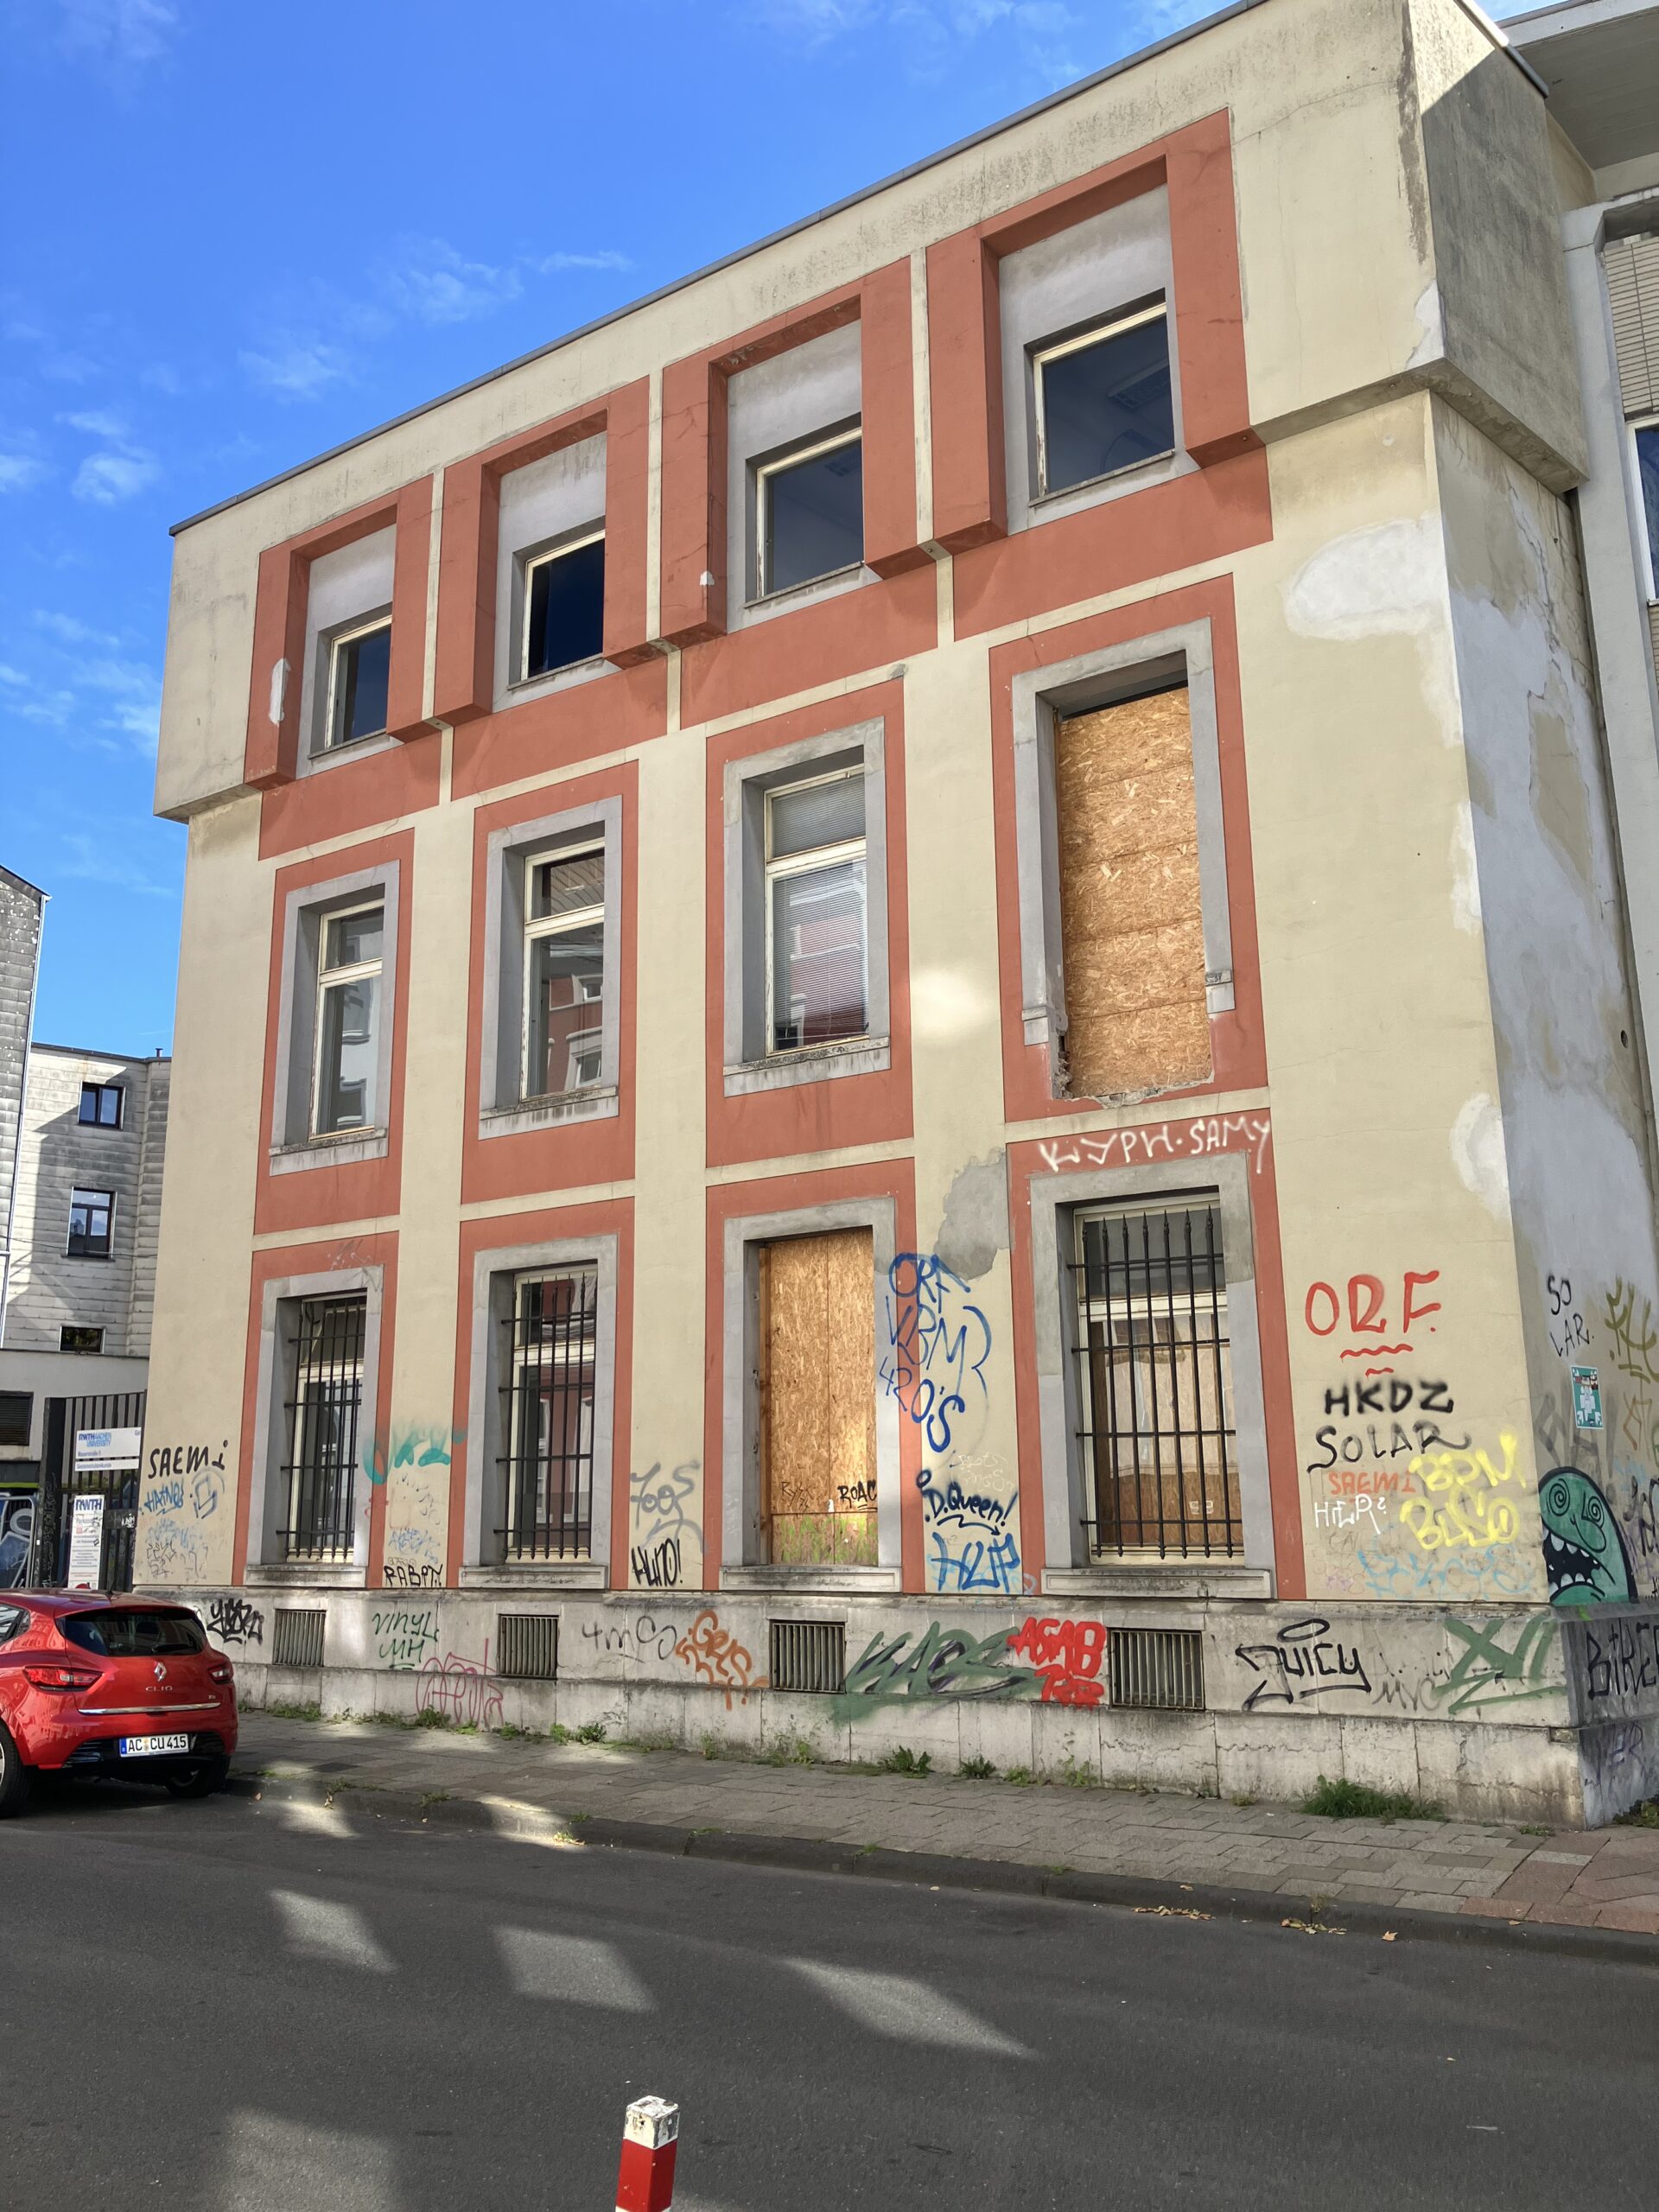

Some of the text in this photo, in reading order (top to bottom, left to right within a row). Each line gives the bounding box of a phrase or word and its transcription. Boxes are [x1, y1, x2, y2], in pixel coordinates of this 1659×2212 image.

[128, 1735, 187, 1752] AC CU 415
